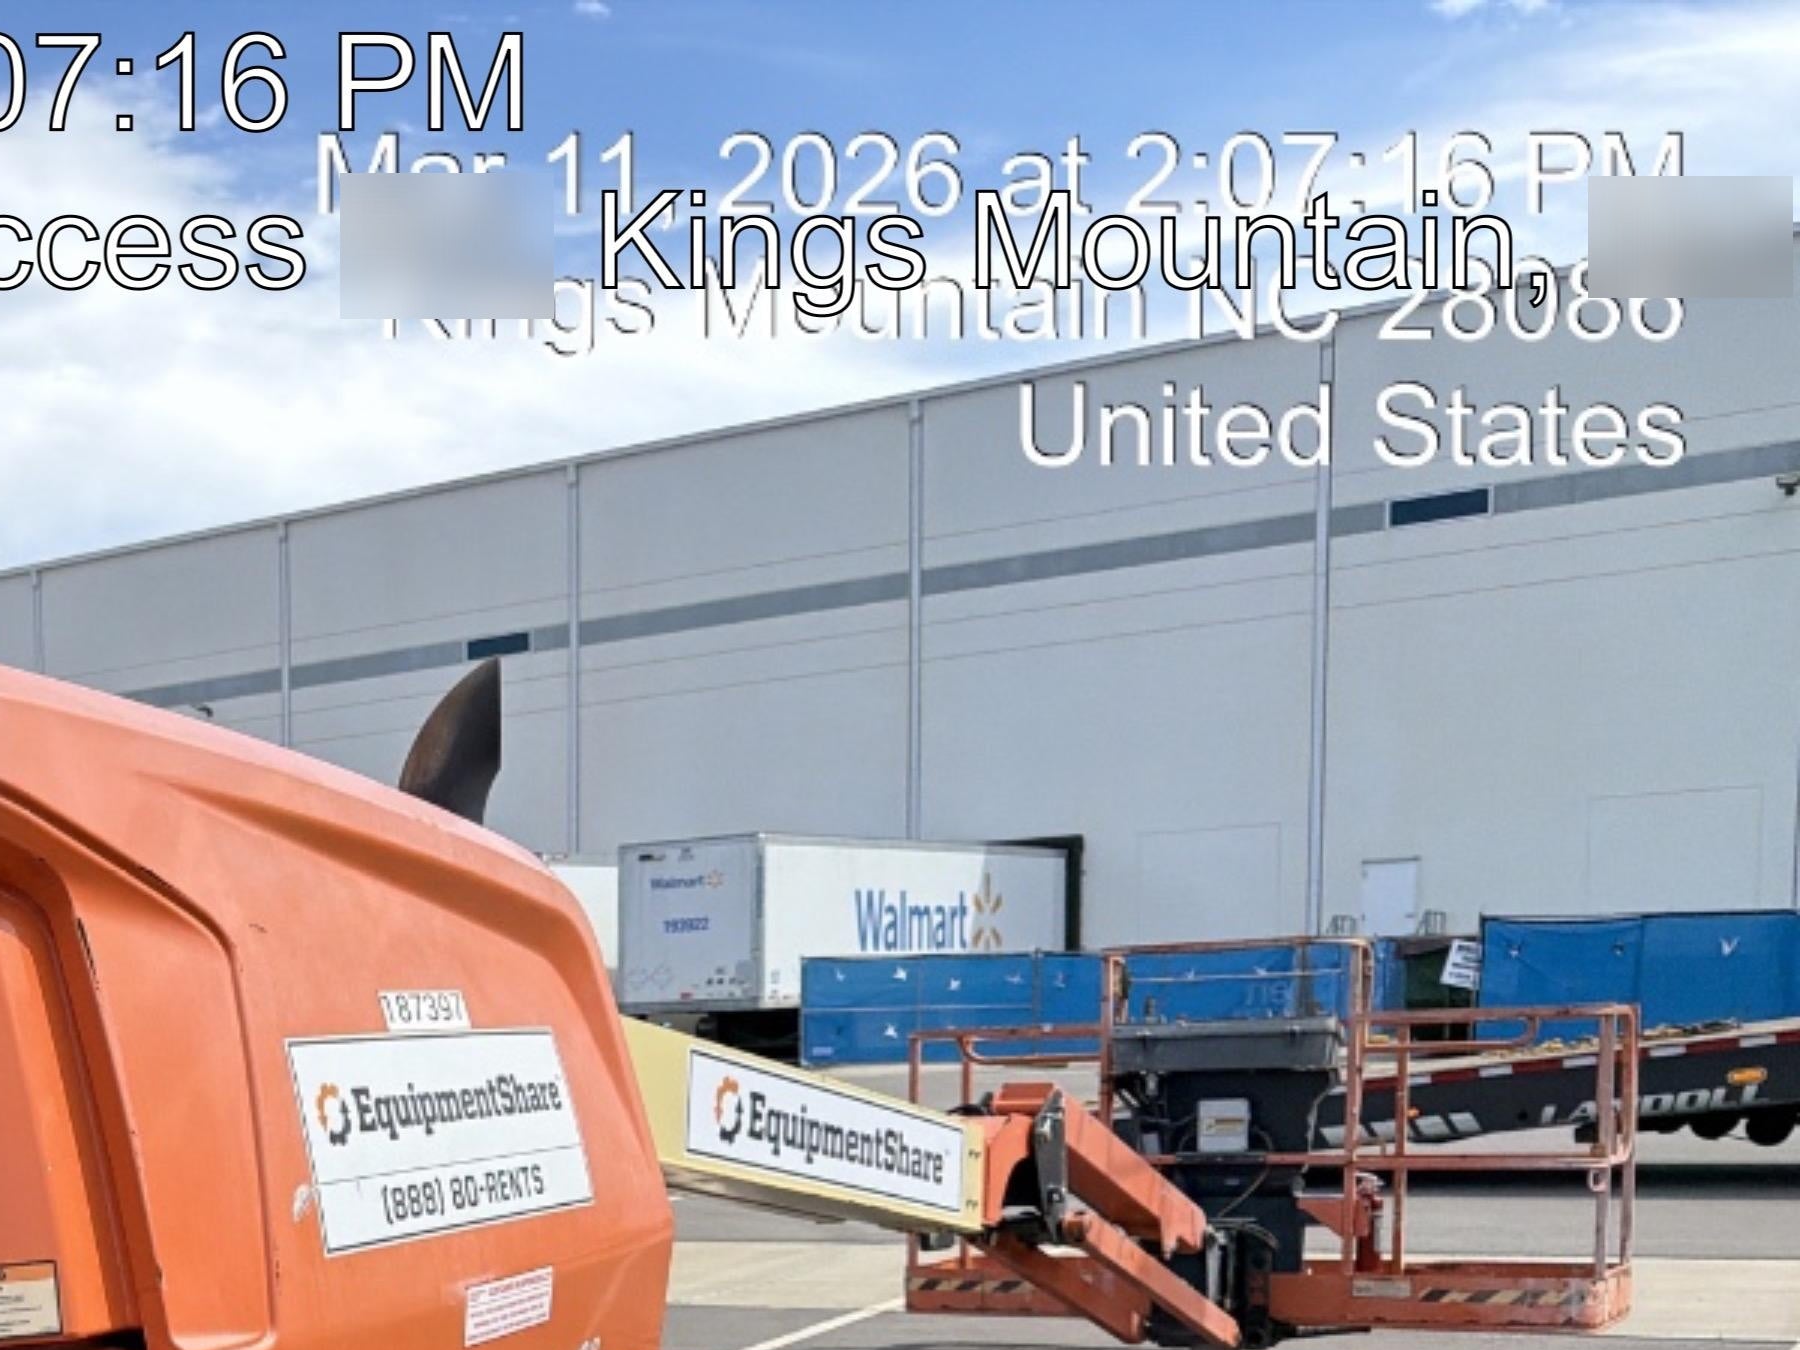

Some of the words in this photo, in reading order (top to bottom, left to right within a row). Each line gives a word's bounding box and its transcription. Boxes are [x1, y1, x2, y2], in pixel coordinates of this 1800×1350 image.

[854, 888, 967, 951] Walmart
[380, 992, 462, 1023] 187397
[350, 1073, 563, 1141] EquipmentShare
[1541, 1084, 1769, 1124] LADOLL
[748, 1091, 944, 1185] EquipmentShare
[380, 1177, 447, 1225] (888)
[450, 1163, 545, 1211] 80-RENTS
